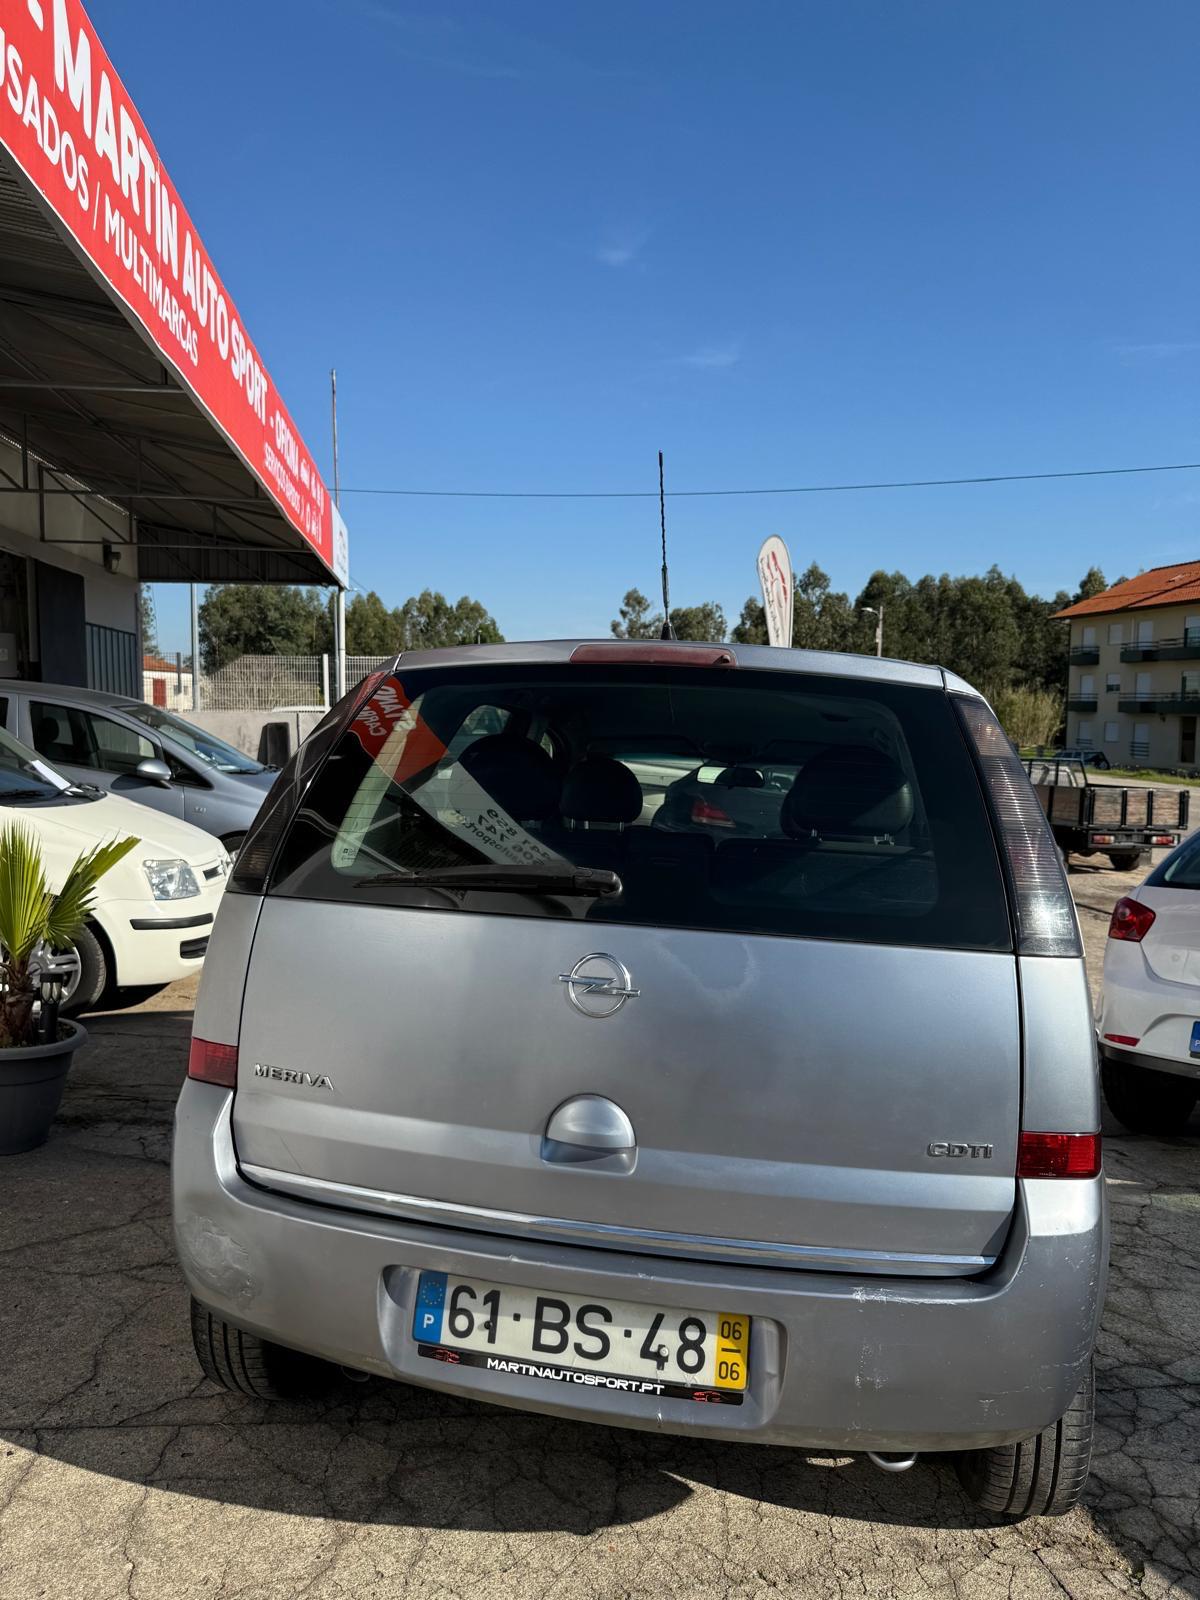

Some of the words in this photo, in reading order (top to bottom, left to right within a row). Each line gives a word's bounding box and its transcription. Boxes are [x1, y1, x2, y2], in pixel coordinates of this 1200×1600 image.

[53, 0, 178, 280] MARTIN
[183, 230, 229, 360] AUTO
[232, 318, 268, 426] SPORT
[105, 193, 199, 366] MULTIMARCAS
[254, 1063, 334, 1091] MERIVA
[423, 1314, 435, 1329] P
[721, 1320, 743, 1341] 06
[487, 1357, 665, 1396] MARTINAUTOSPORT.PT
[718, 1360, 741, 1382] 06
